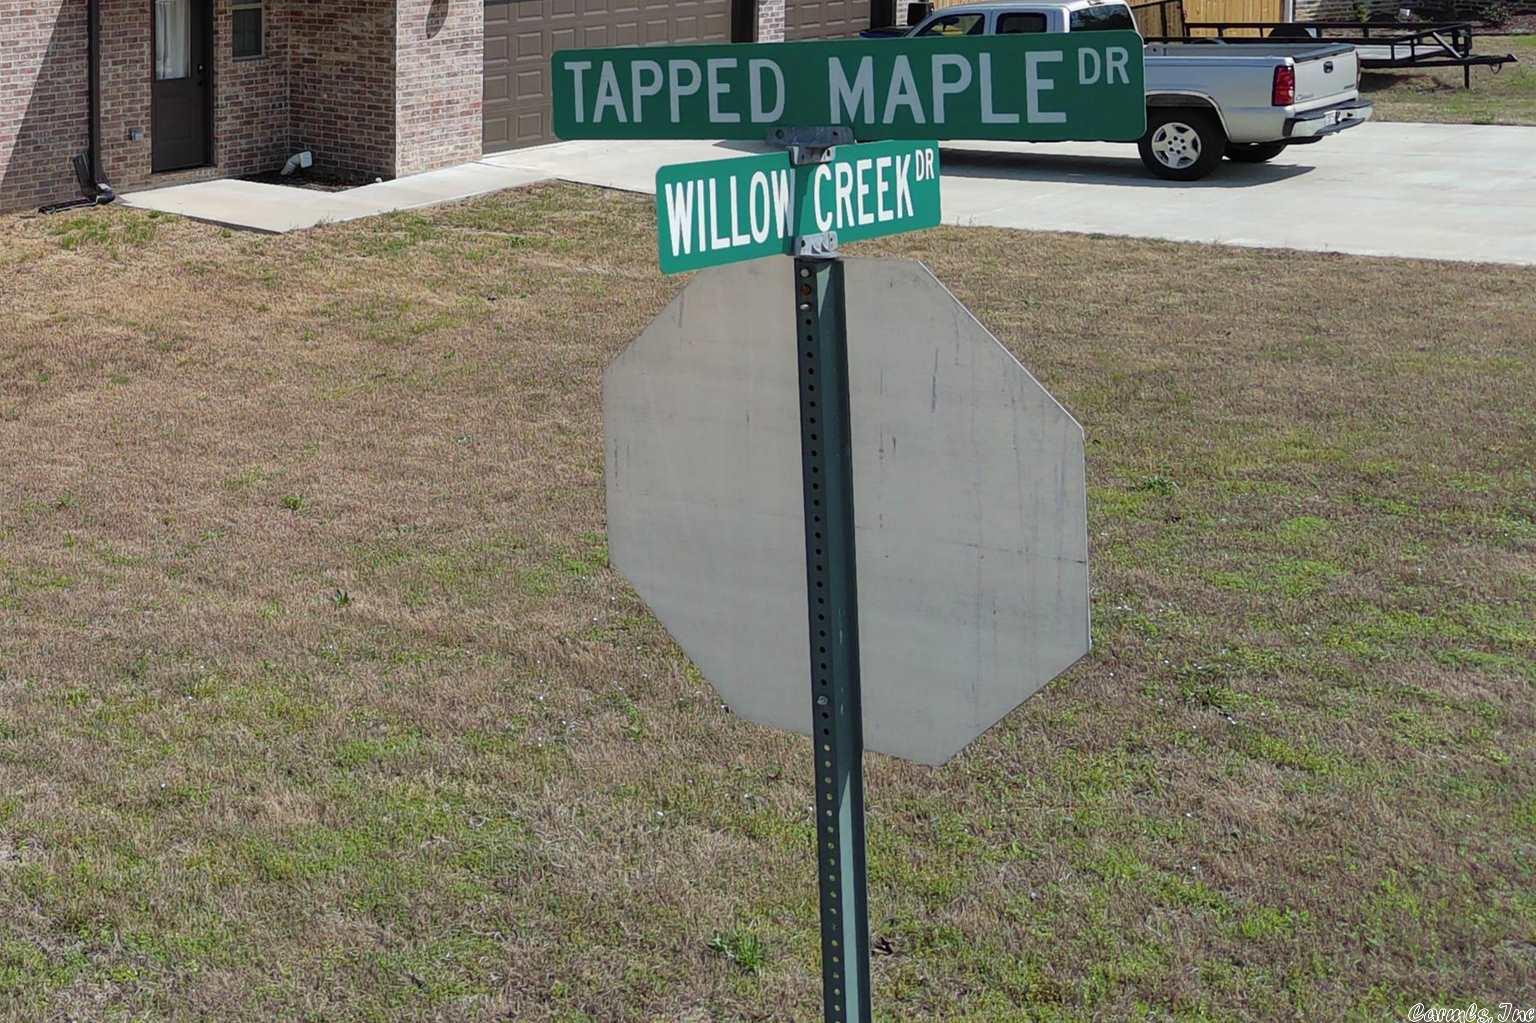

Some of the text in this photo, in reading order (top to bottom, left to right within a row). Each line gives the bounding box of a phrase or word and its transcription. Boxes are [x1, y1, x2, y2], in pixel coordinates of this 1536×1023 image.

[563, 46, 1131, 125] TAPPED MAPLE DR
[664, 147, 936, 257] WILLOW CREEK DR
